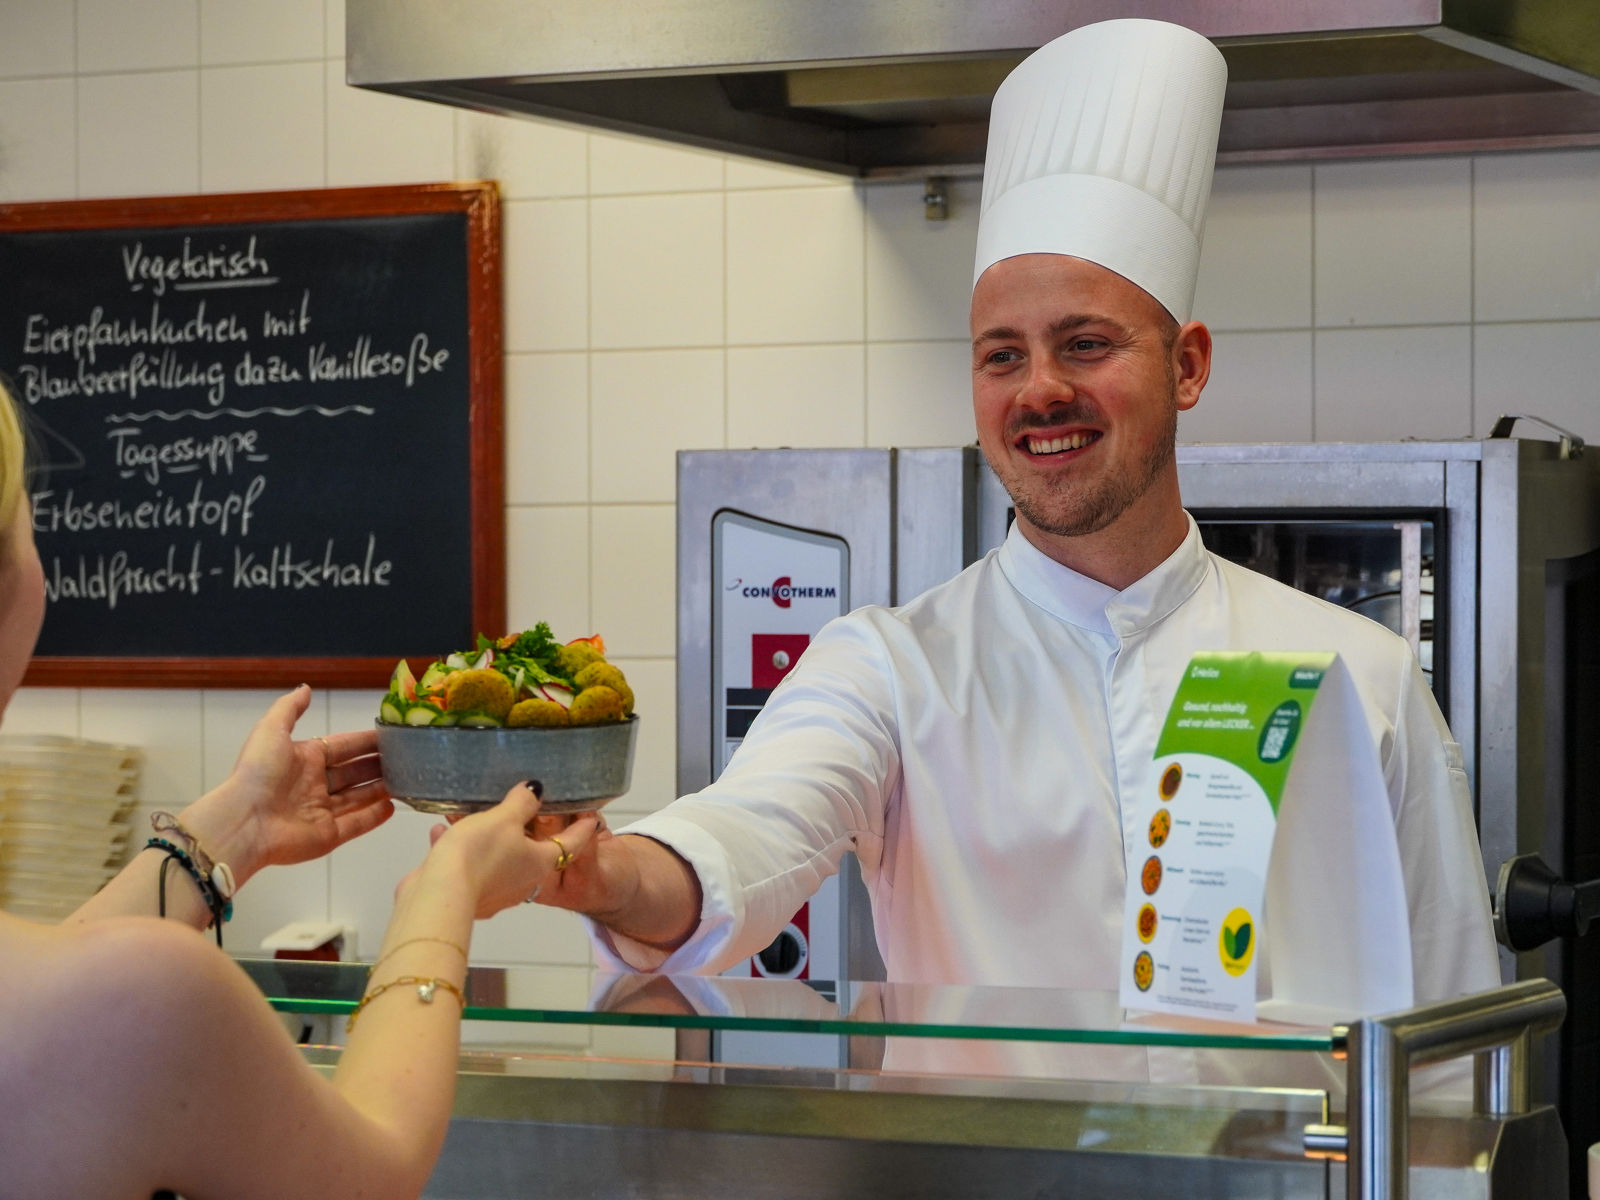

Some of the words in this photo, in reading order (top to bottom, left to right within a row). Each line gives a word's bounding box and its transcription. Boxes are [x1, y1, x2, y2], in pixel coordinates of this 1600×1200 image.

[123, 235, 269, 295] Vegetarisch
[263, 289, 311, 336] mit
[235, 352, 301, 387] dazu
[107, 428, 258, 484] Tagessuppe
[233, 532, 392, 588] Kaltschale
[742, 586, 837, 599] CONVOTHERM
